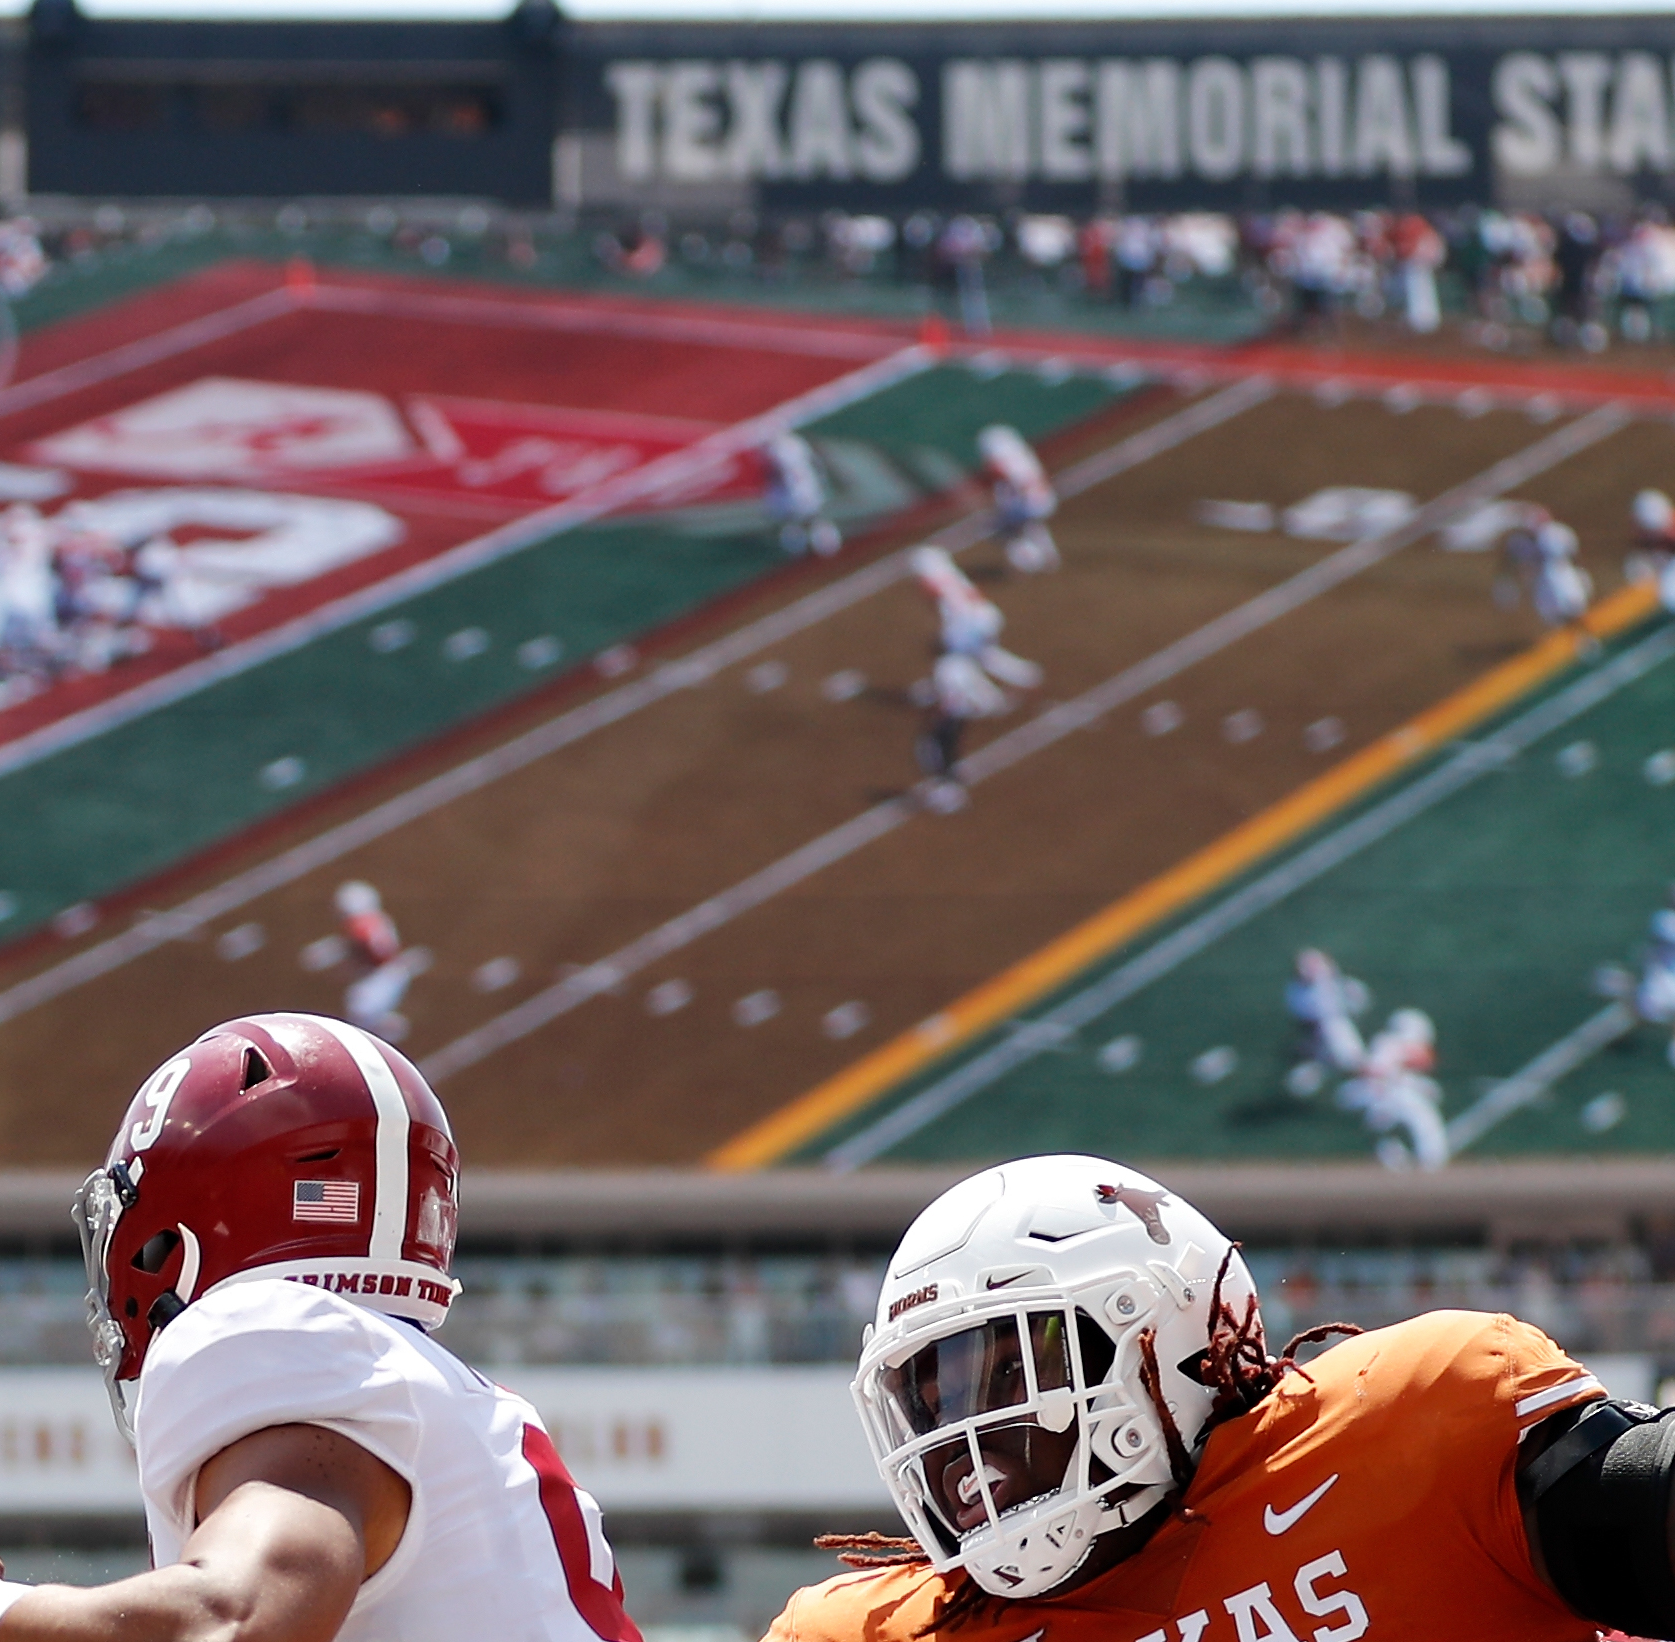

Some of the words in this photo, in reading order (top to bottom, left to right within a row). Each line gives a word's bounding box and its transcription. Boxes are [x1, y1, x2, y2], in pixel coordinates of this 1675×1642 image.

[606, 57, 921, 181] TEXAS
[940, 53, 1472, 181] MEMORIAL
[130, 1057, 192, 1152] 9
[888, 1283, 939, 1323] HORNS
